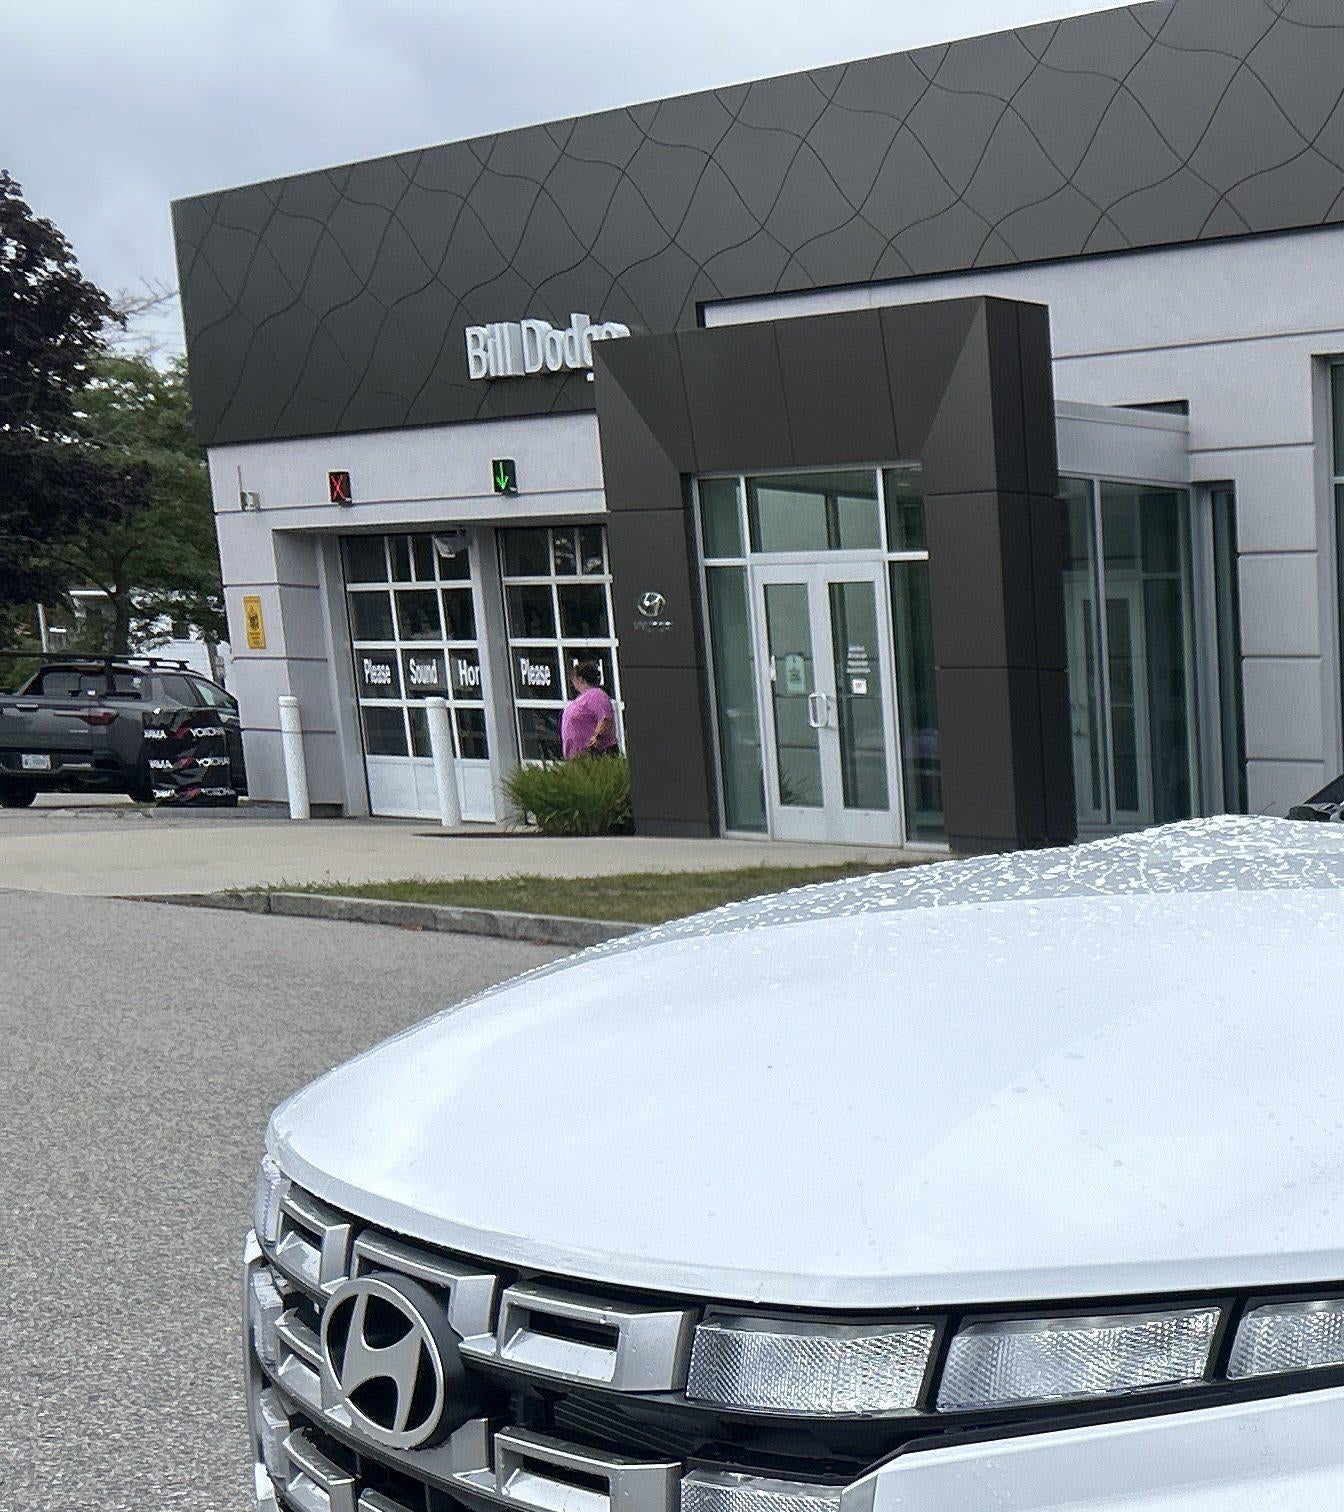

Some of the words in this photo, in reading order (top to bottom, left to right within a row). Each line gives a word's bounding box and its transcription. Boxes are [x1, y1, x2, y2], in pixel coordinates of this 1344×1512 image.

[465, 322, 524, 380] Bill
[520, 313, 631, 382] Dod
[363, 658, 391, 685] Please
[409, 658, 438, 685] Sound
[458, 658, 480, 687] Hor
[520, 657, 550, 687] Please
